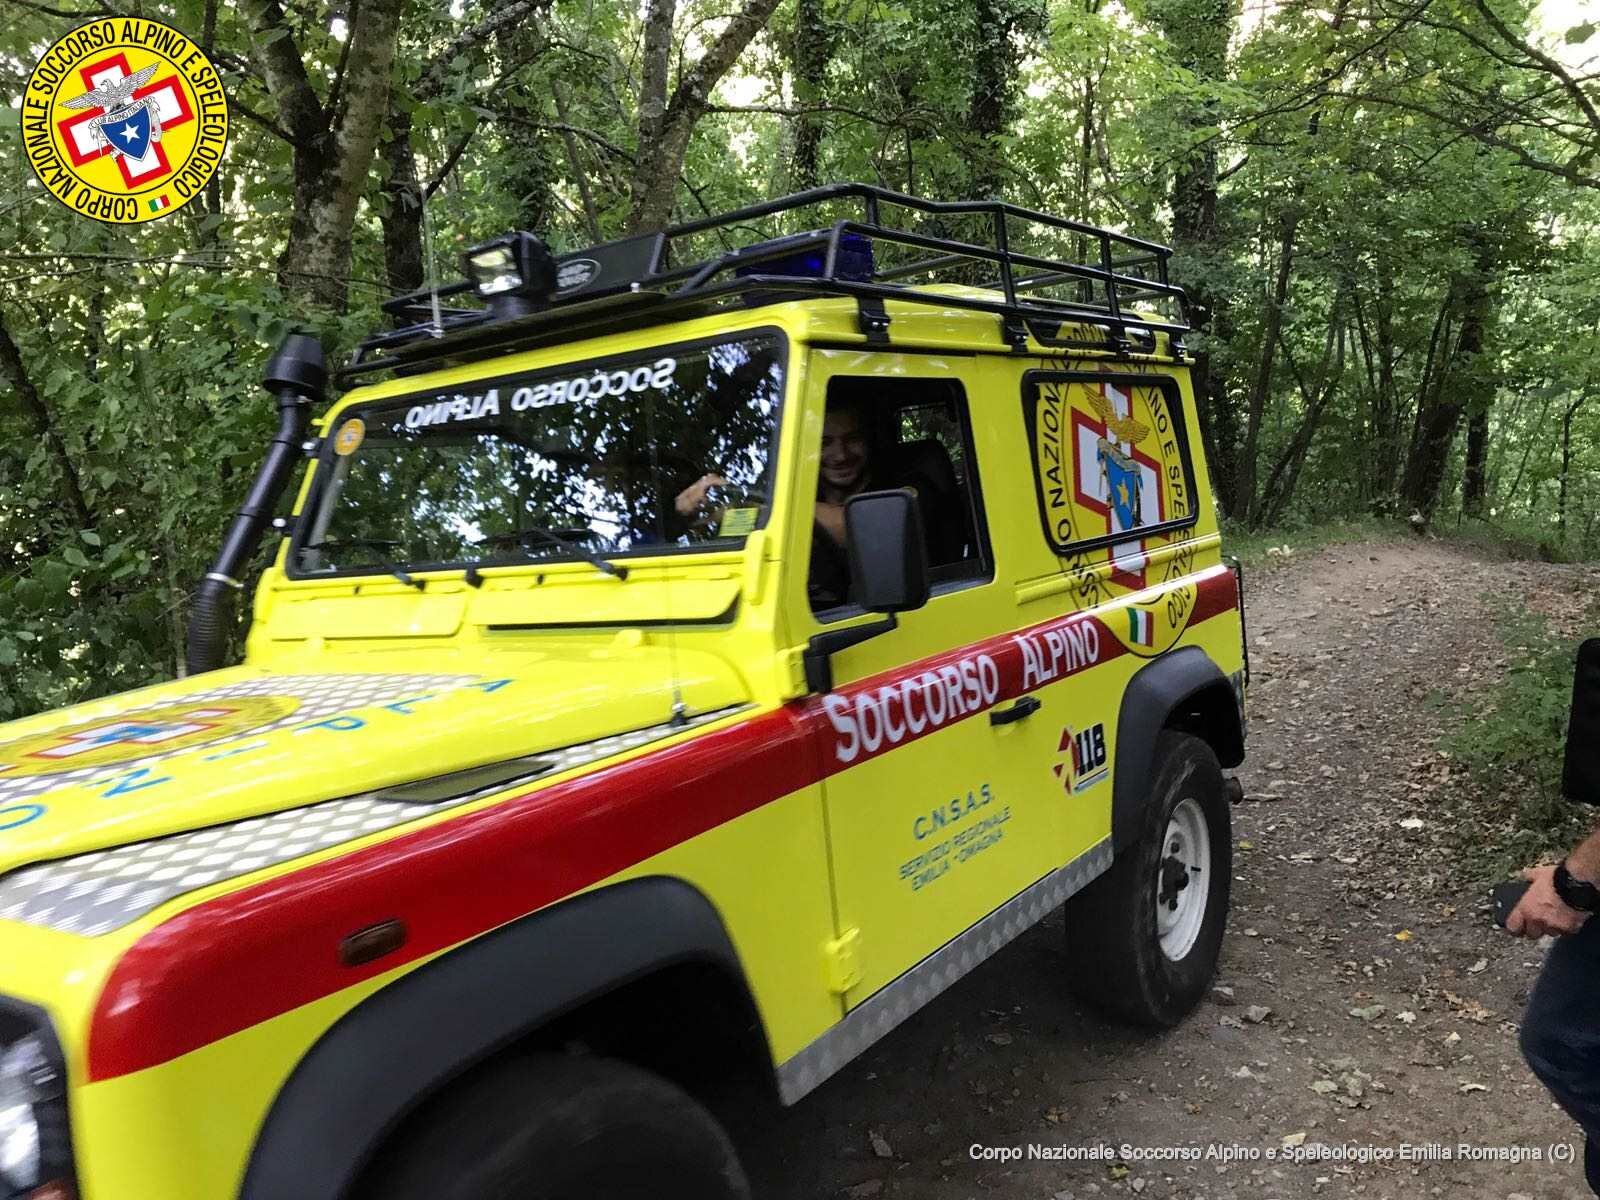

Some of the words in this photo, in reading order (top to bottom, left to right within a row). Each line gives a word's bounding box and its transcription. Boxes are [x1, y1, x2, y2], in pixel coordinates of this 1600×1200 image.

[821, 654, 999, 763] SOCCORSO
[1014, 620, 1099, 690] ALPINO
[1074, 722, 1107, 777] 118
